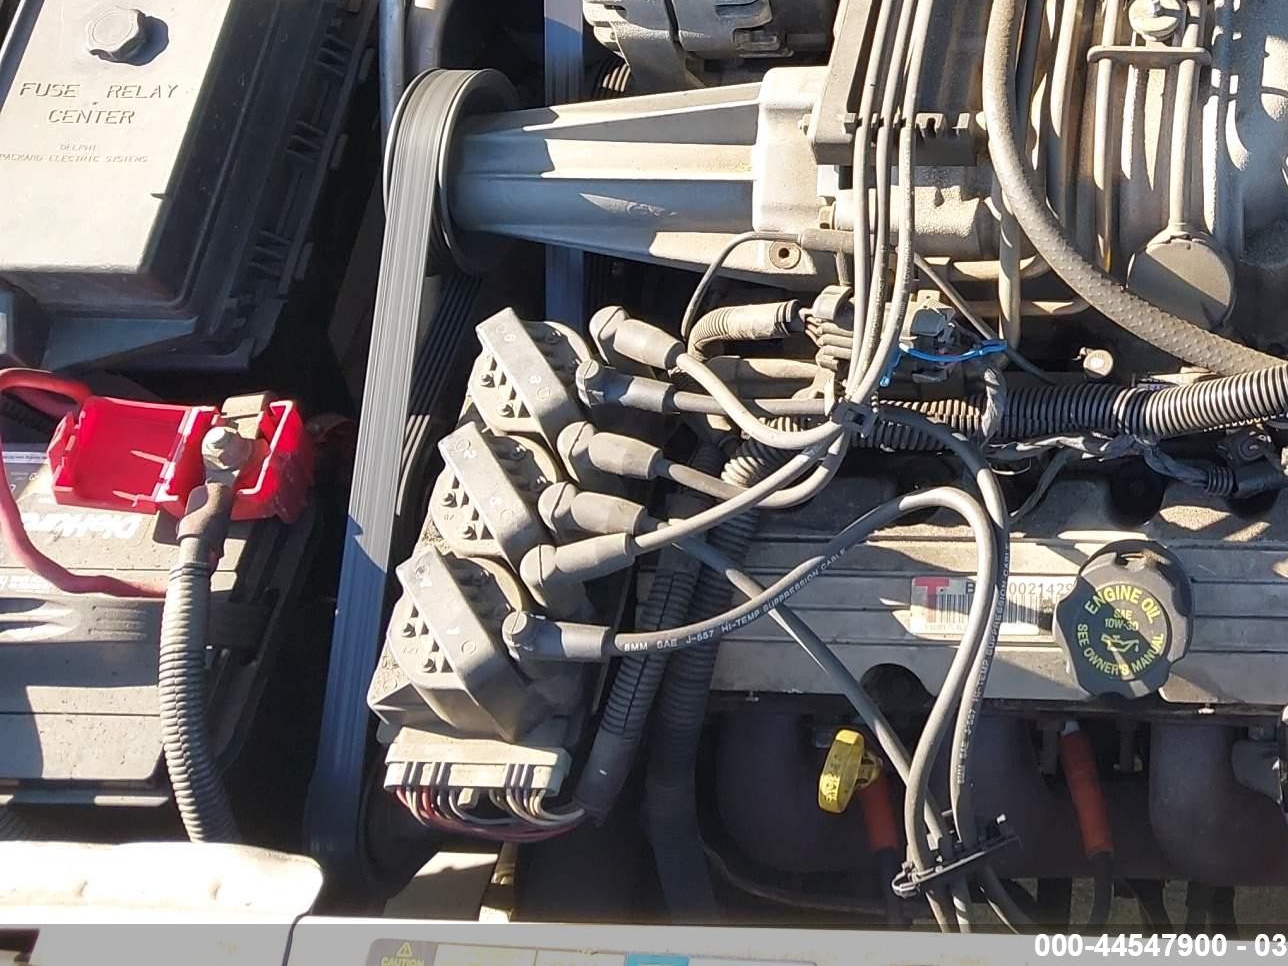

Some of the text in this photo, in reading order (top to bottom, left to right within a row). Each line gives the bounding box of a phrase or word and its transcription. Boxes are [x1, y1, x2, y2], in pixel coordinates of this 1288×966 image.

[19, 83, 179, 98] FUSE RELAY
[48, 109, 135, 124] CENTER
[656, 638, 678, 650] SAE
[721, 609, 761, 633] HI-TEMP
[762, 570, 820, 613] SUPPRESSION
[1084, 583, 1162, 624] ENGINE OIL
[1113, 609, 1132, 619] SAE
[1105, 618, 1139, 631] 10W-30
[1077, 623, 1164, 676] SEE OWNER'S MANUAL
